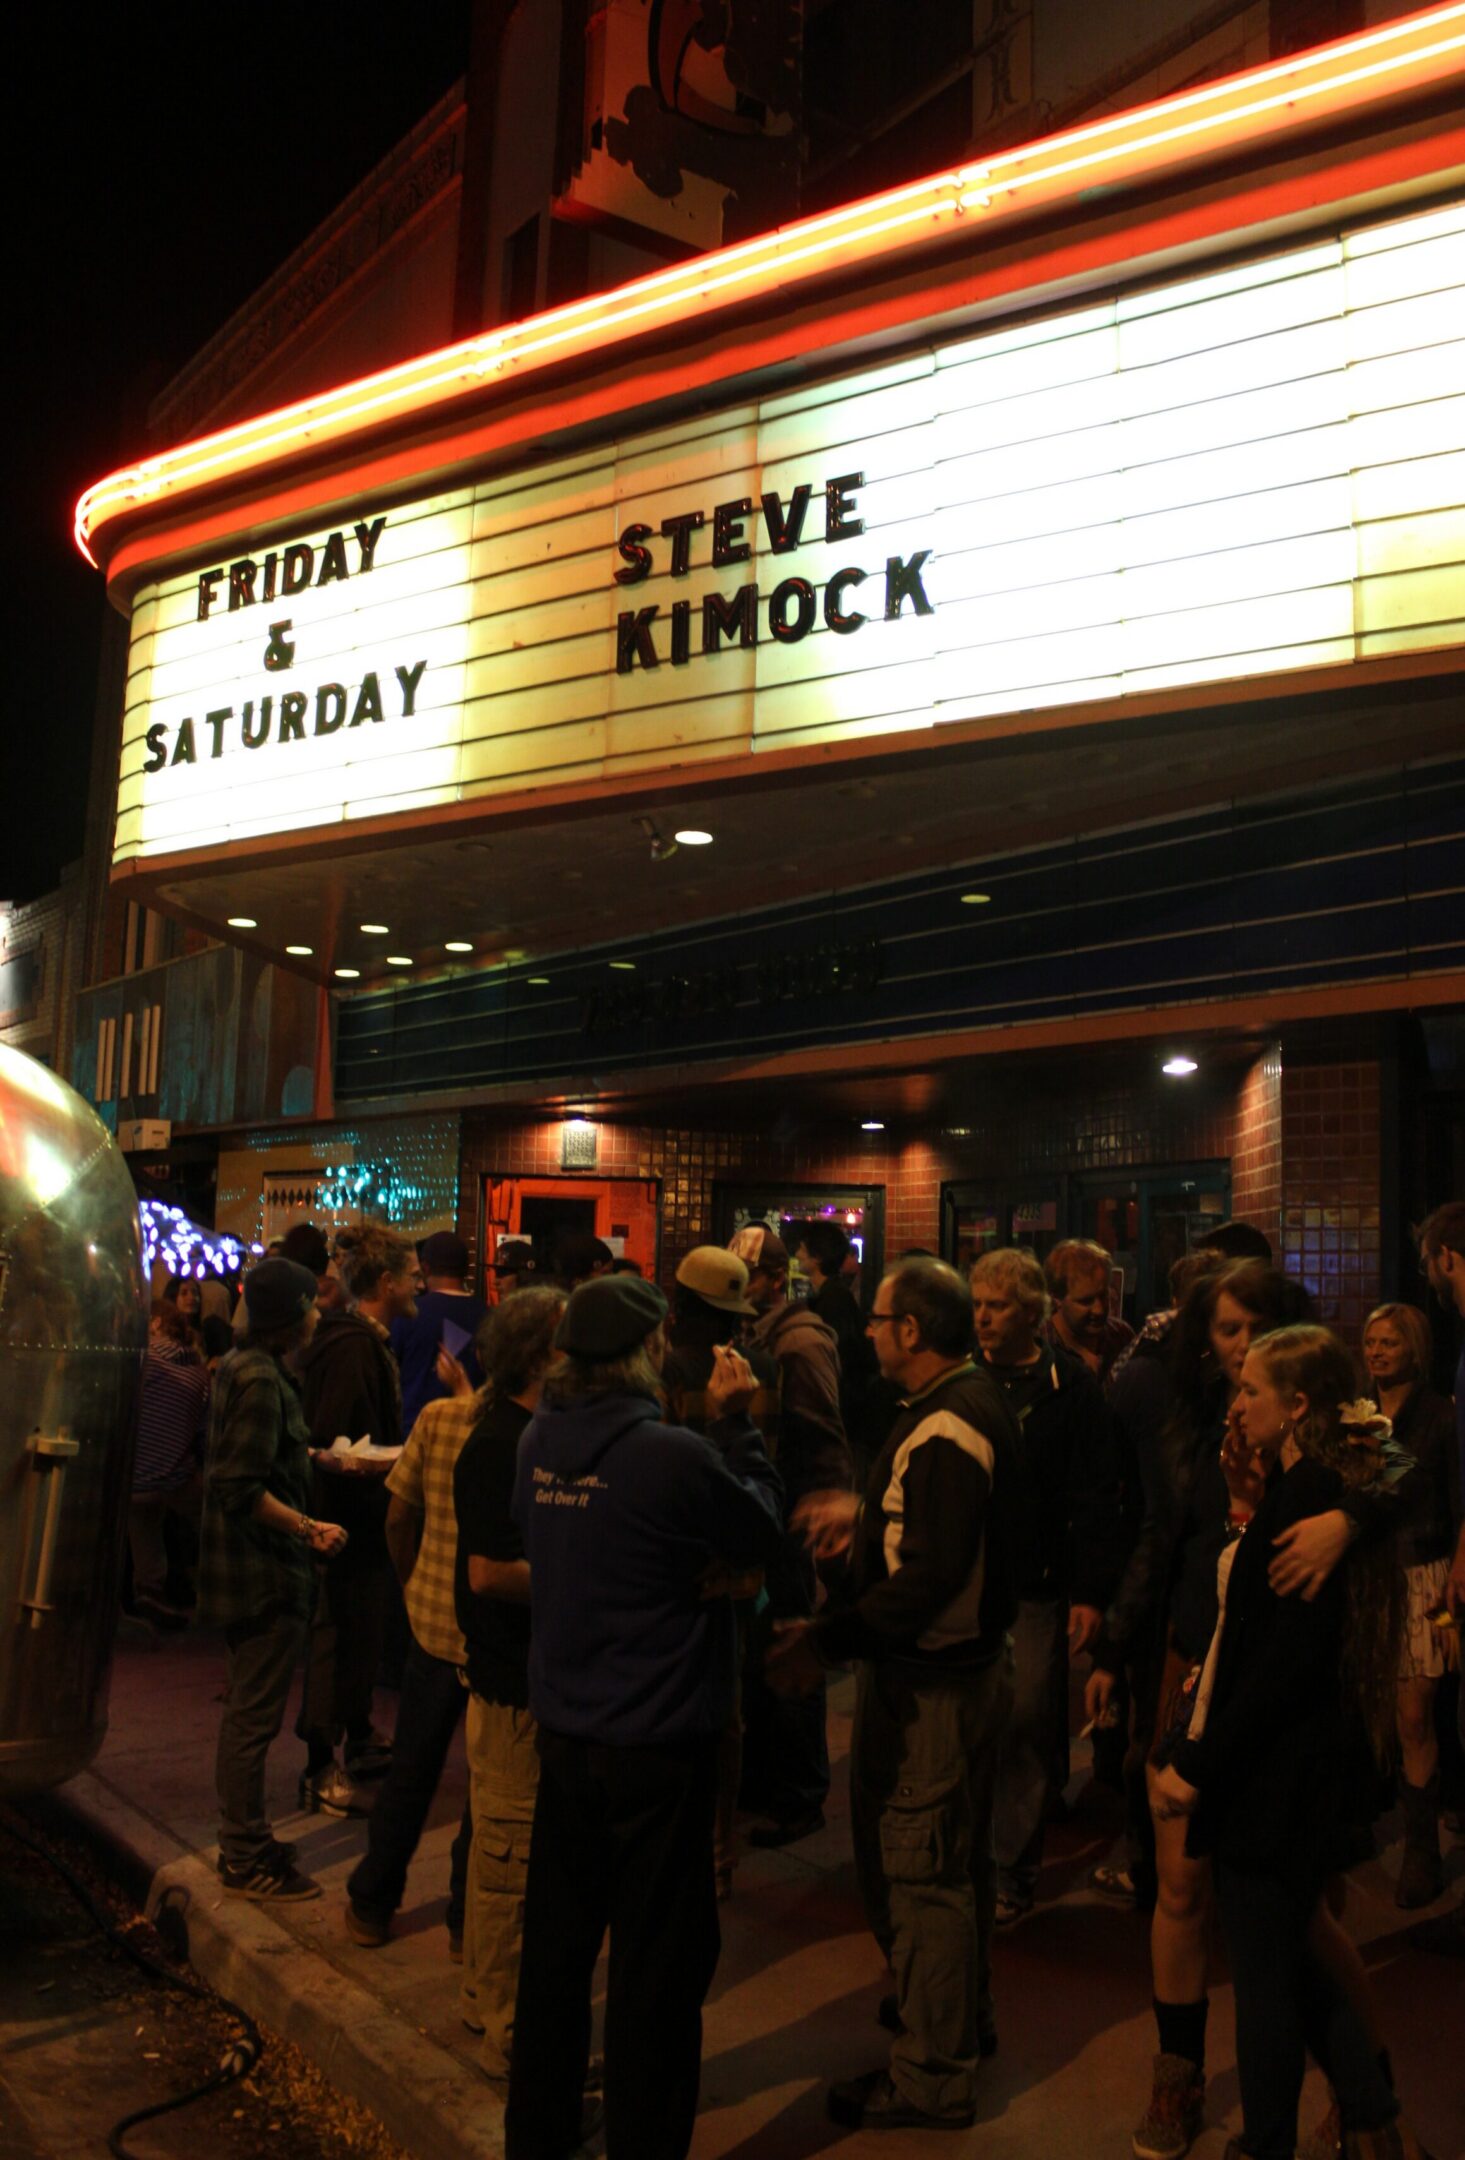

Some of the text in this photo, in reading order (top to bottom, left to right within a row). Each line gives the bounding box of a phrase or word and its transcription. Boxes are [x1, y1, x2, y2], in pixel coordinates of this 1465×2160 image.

[197, 516, 387, 622] FRIDAY
[614, 471, 865, 585] STEVE
[264, 619, 295, 671] &
[617, 549, 935, 675] KIMOCK
[143, 660, 427, 773] SATURDAY
[535, 1488, 589, 1508] Get Over It
